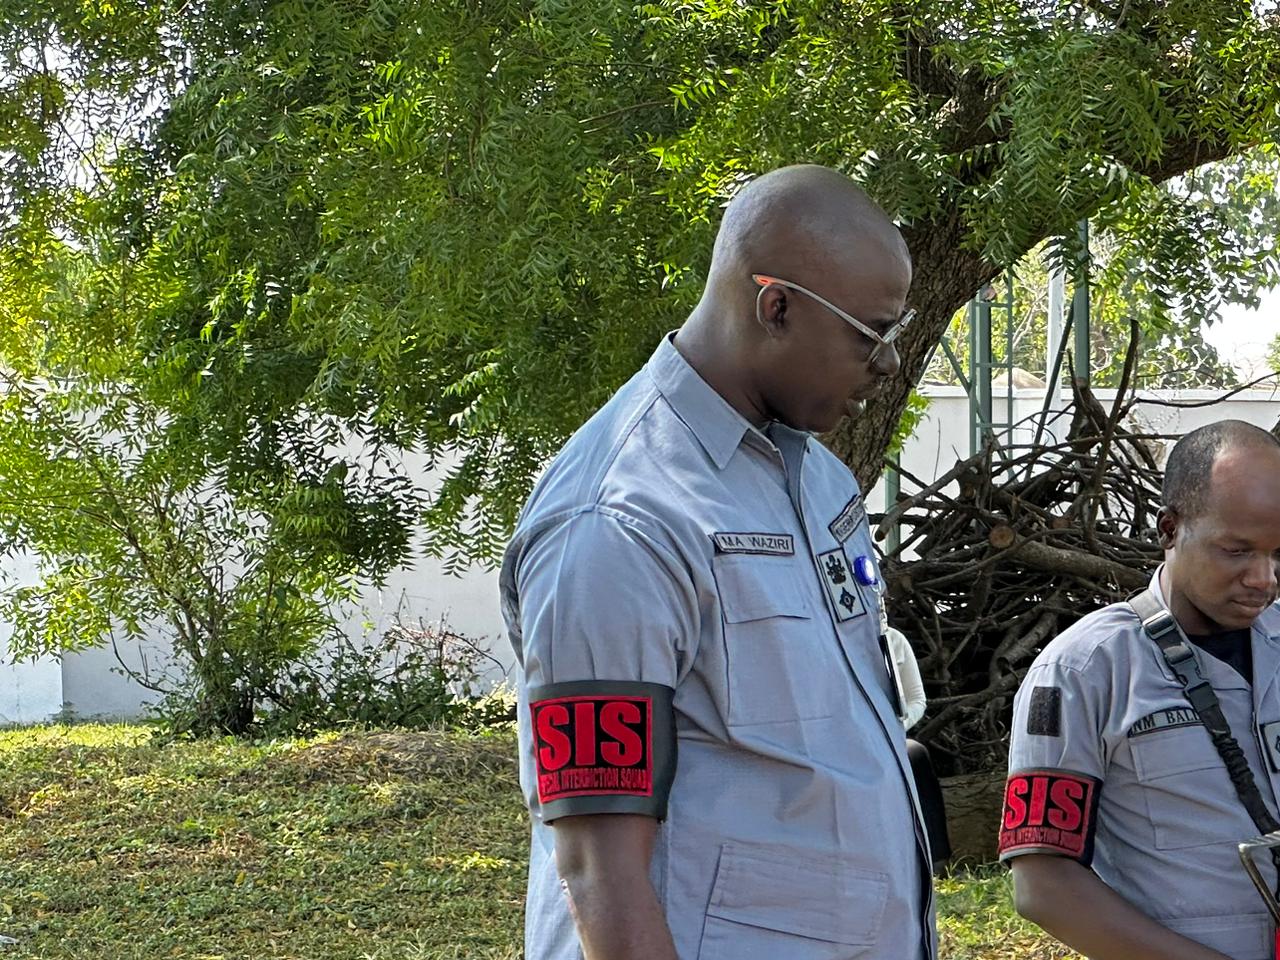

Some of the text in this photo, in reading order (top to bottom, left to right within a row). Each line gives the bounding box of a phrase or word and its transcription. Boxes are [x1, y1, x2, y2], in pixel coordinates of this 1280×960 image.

[747, 535, 790, 550] WAZIRI
[537, 701, 643, 771] SIS
[1005, 776, 1083, 831] SIS
